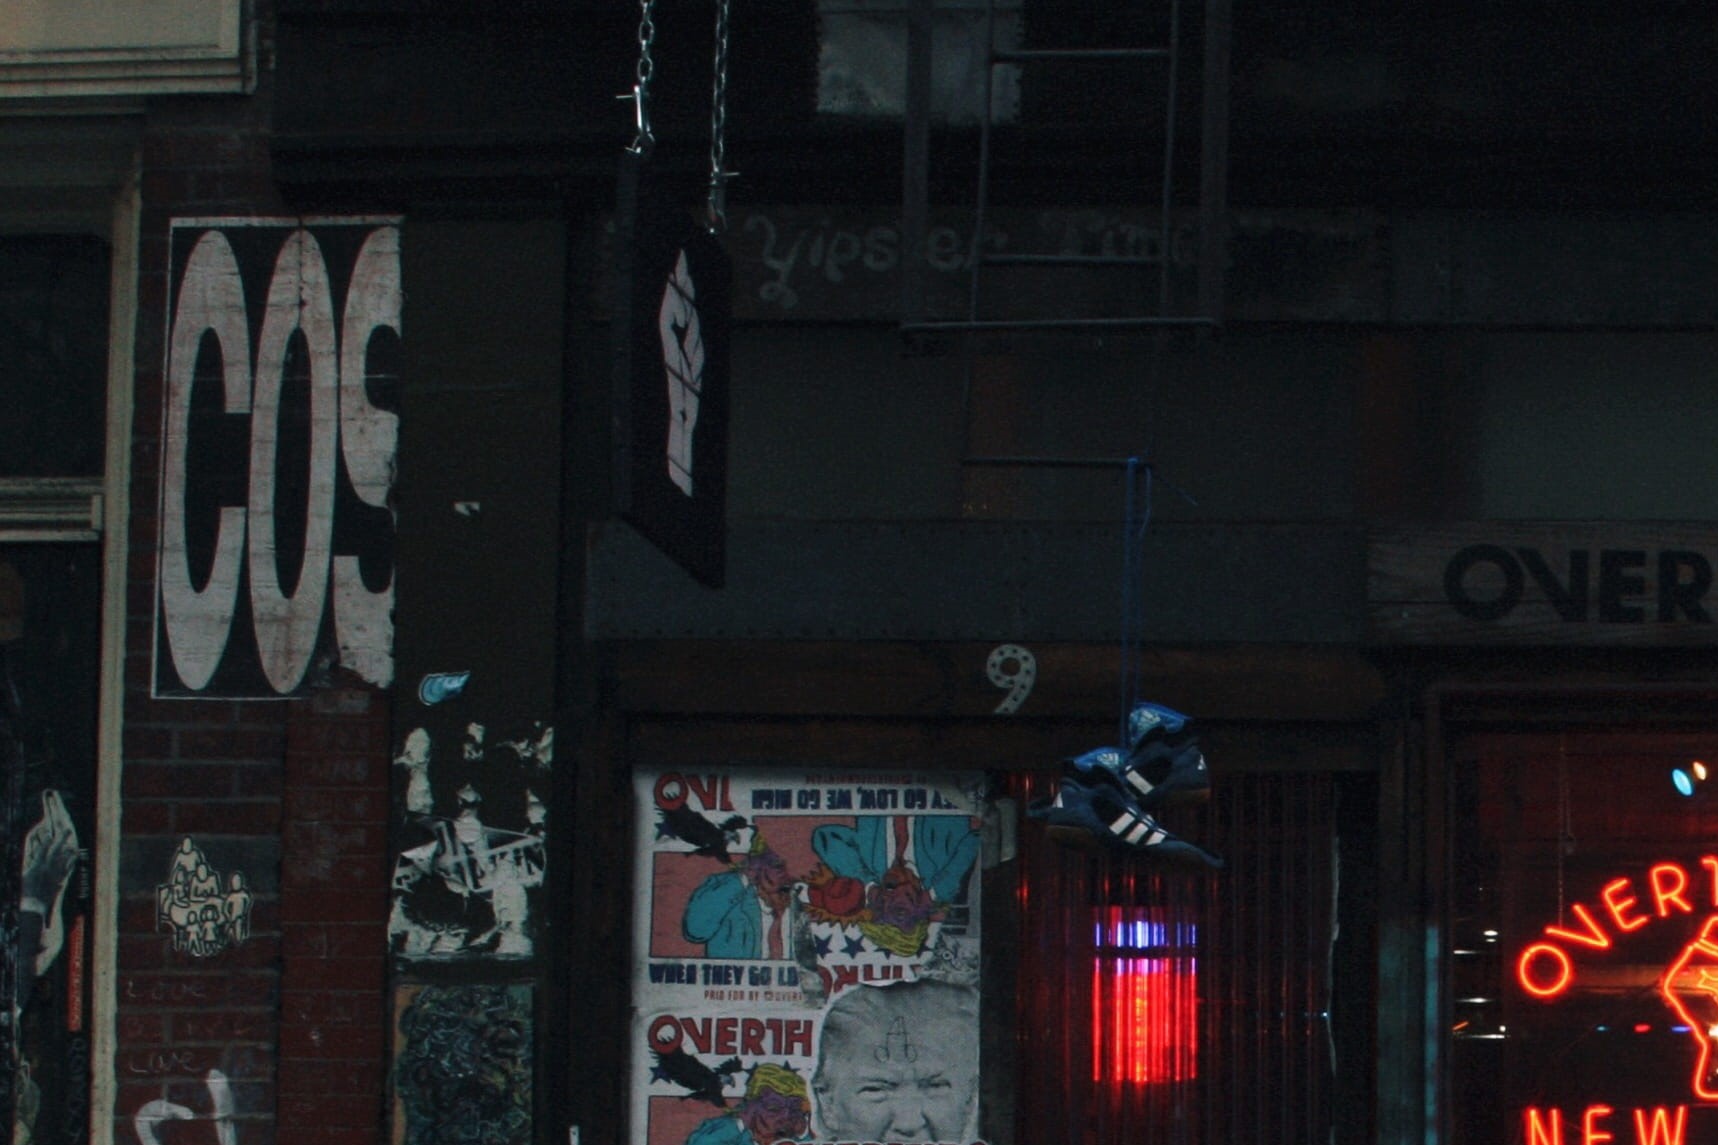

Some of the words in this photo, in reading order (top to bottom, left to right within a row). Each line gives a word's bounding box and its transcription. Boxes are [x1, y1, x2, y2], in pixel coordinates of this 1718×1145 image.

[986, 644, 1036, 715] 9
[650, 963, 697, 985] WHEN
[702, 964, 745, 986] THEY
[749, 966, 772, 987] GO
